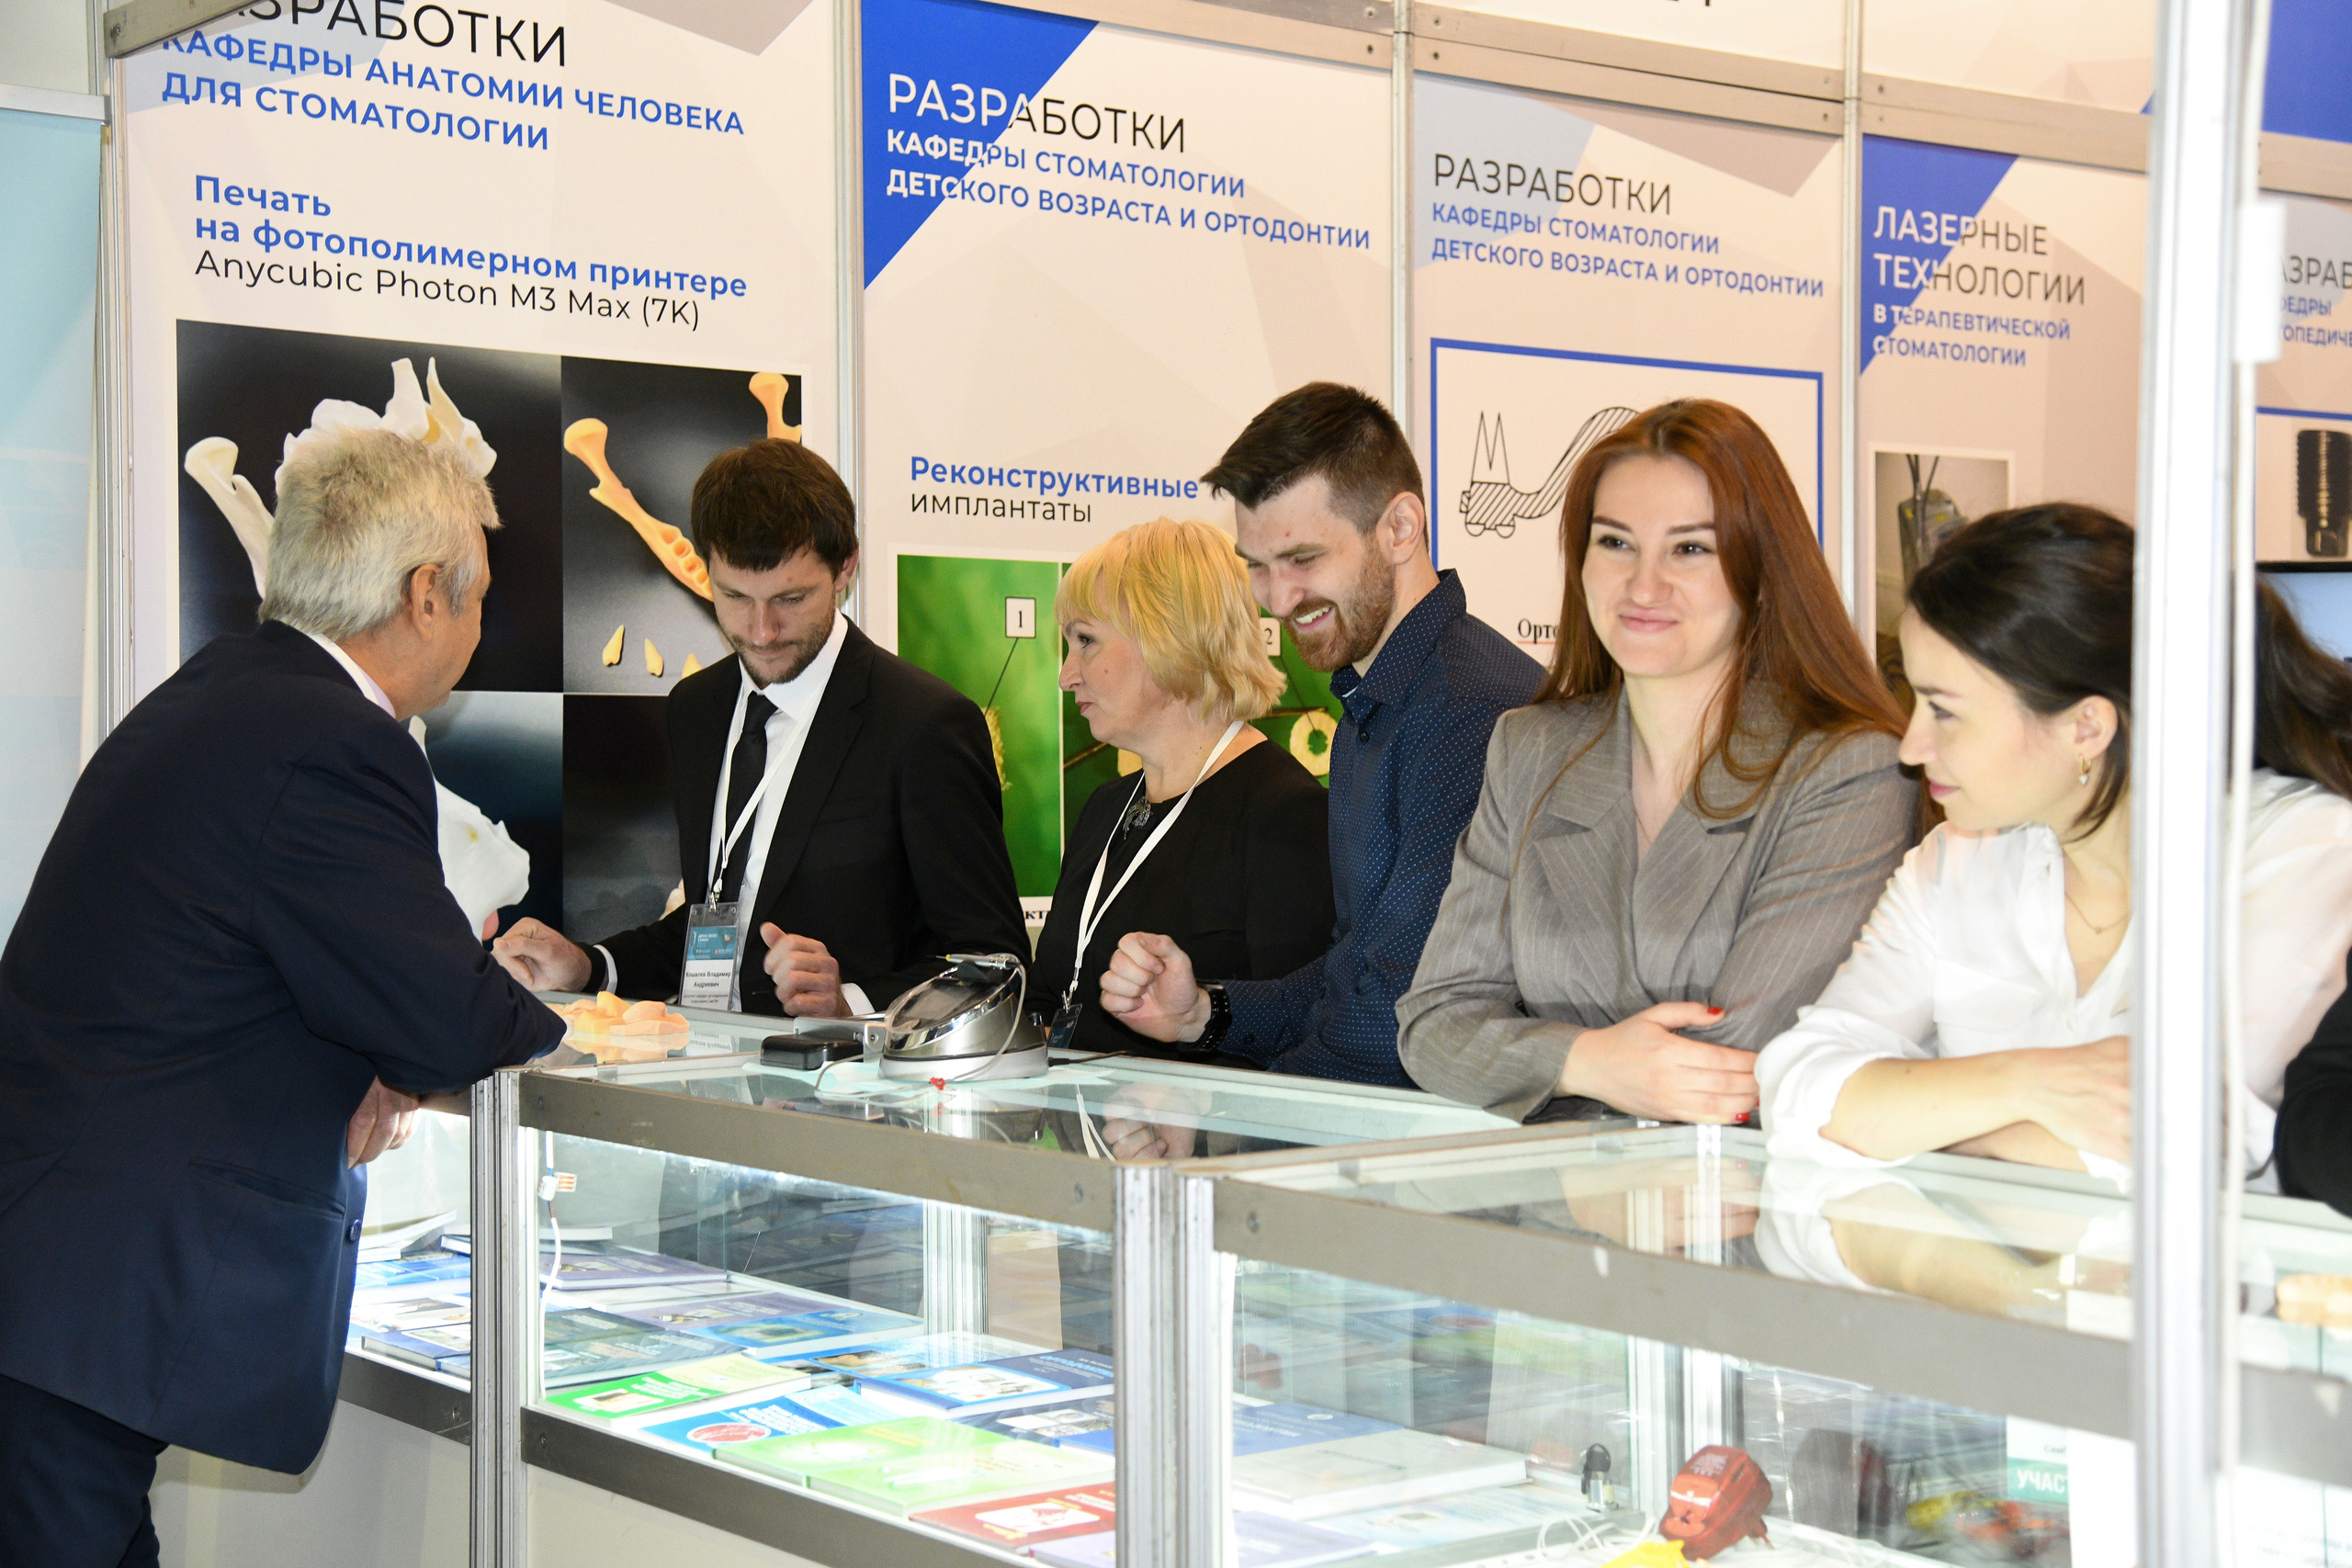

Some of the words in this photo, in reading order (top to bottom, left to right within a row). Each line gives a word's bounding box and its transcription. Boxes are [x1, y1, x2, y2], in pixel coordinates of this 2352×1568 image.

[238, 0, 568, 67] РАБОТКИ
[163, 72, 242, 107] ДЛЯ
[255, 86, 548, 151] СТОМАТОЛОГИИ
[365, 58, 563, 109] АНАТОМИИ
[574, 89, 745, 136] ЧЕЛОВЕКА
[889, 73, 1185, 153] РАЗРАБОТКИ
[887, 129, 1025, 170] КАФЕДРЫ
[1035, 151, 1245, 198] СТОМАТОЛОГИИ
[1435, 153, 1671, 215] РАЗРАБОТКИ
[195, 175, 331, 218] Печать
[887, 169, 1029, 208] ДЕТСКОГО
[1039, 190, 1170, 226] ВОЗРАСТА
[1181, 209, 1195, 230] И
[1204, 209, 1369, 250] ОРТОДОНТИИ
[1432, 203, 1541, 233] КАФЕДРЫ
[1549, 218, 1719, 254] СТОМАТОЛОГИИ
[1873, 206, 2048, 255] ЛАЗЕРНЫЕ
[195, 218, 241, 245] на
[254, 220, 578, 281] фотополимерном
[589, 261, 747, 299] принтере
[1432, 238, 1544, 268] ДЕТСКОГО
[1551, 253, 1658, 281] ВОЗРАСТА
[1666, 265, 1679, 283] И
[1685, 266, 1824, 298] ОРТОДОНТИИ
[1873, 253, 2086, 305] ТЕХНОЛОГИИ
[2282, 255, 2352, 289] ЗРАБ
[195, 250, 362, 294] Anycubic
[377, 271, 498, 307] Photon
[512, 286, 556, 313] M3
[570, 291, 631, 321] Max
[641, 295, 699, 332] (7K)
[2282, 295, 2332, 317] ЕДРЫ
[1874, 305, 1886, 322] В
[1891, 306, 2071, 340] ТЕРАПЕВТИЧЕСКОЙ
[2281, 324, 2352, 347] ОПЕДИЧ
[1873, 335, 2026, 367] СТОМАТОЛОГИИ
[910, 456, 1198, 499] Реконструктивные
[910, 494, 1091, 523] имплантаты
[1017, 611, 1024, 628] 1
[1264, 627, 1272, 645] 2
[1518, 618, 1559, 644] Орто
[2017, 1468, 2067, 1494] УЧАС
